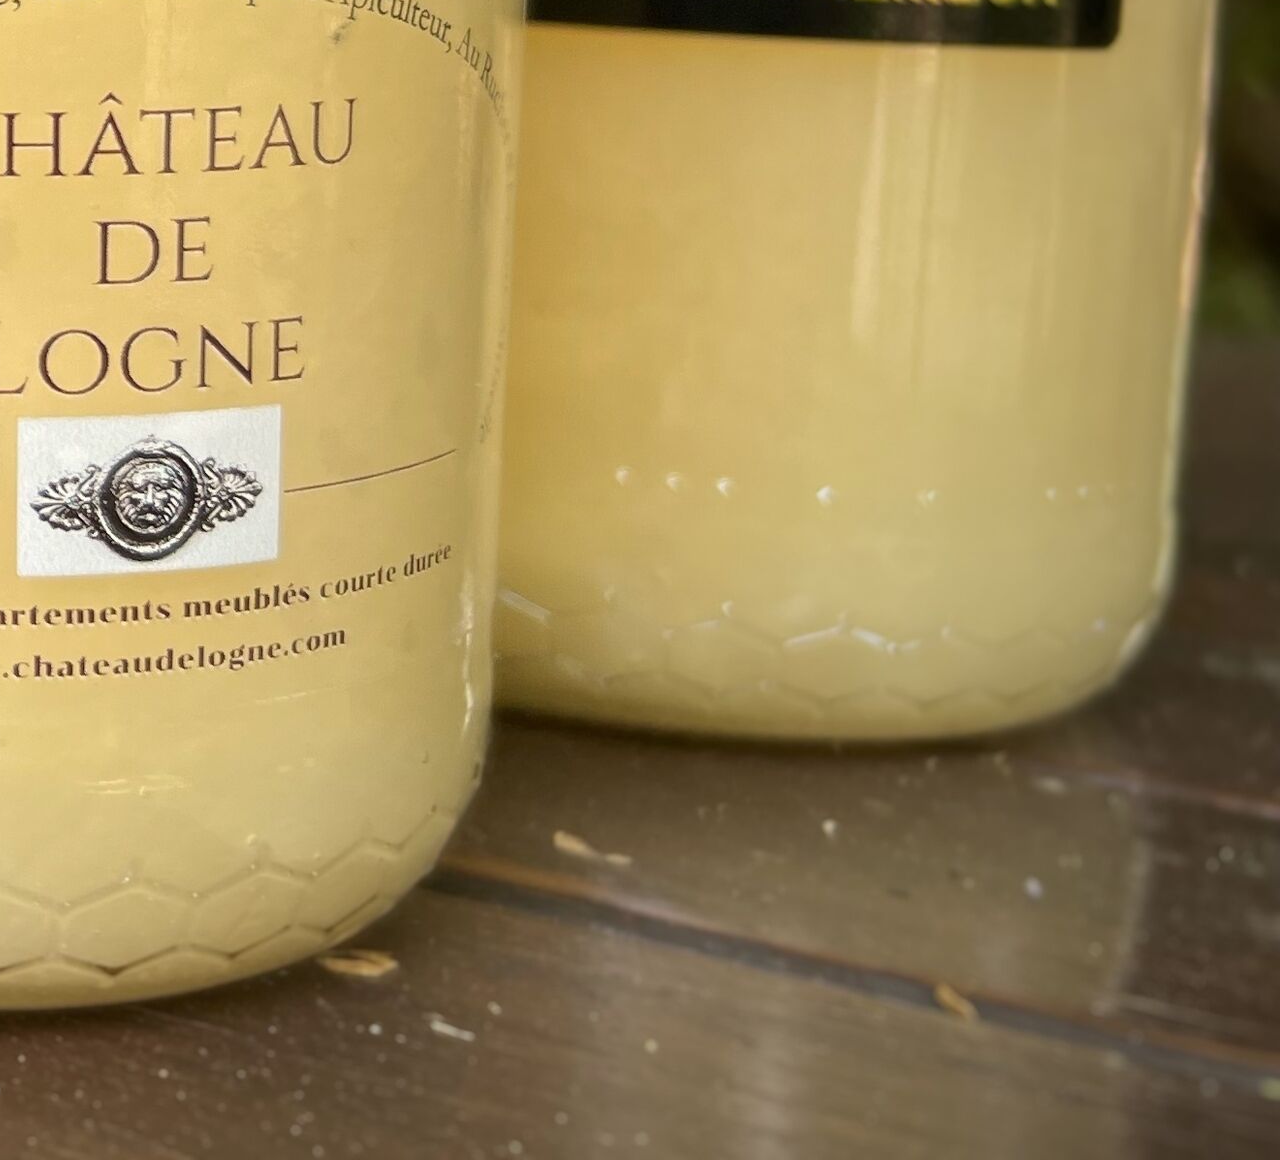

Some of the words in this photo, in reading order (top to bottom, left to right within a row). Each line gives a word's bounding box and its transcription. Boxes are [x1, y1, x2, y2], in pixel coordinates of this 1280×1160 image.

[455, 27, 481, 71] Au
[93, 216, 214, 286] DE
[183, 582, 311, 619] meublés
[319, 565, 397, 599] courte
[403, 543, 453, 577] durée
